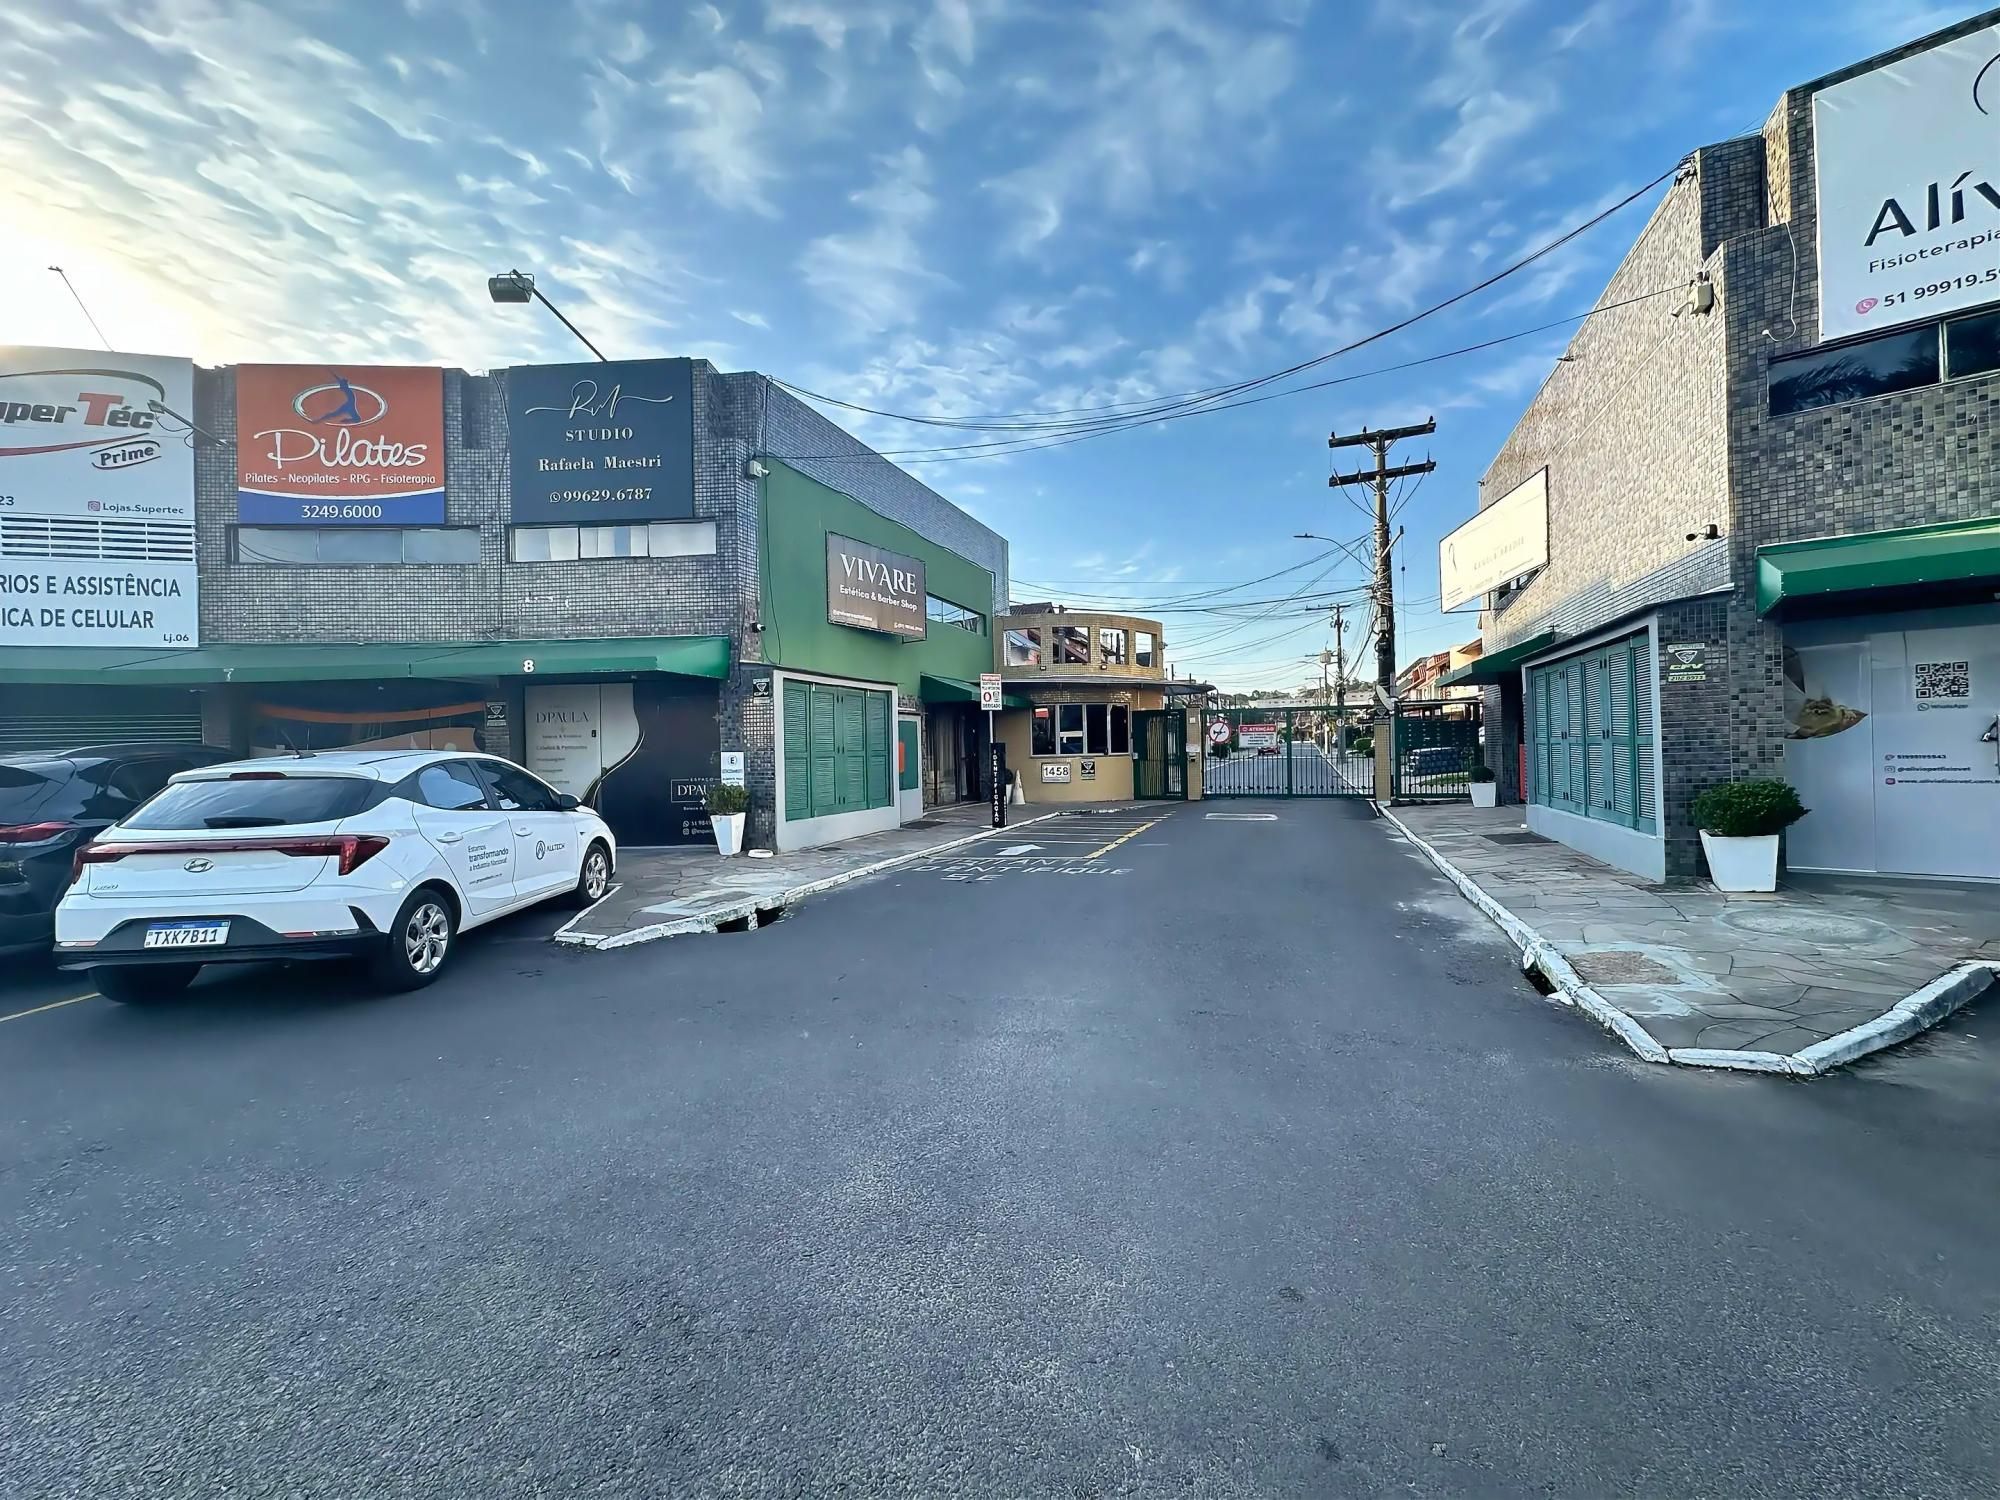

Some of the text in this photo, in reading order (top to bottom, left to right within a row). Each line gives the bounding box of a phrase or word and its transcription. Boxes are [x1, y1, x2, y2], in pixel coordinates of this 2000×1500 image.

[1884, 268, 2000, 307] 51 99919.5
[566, 427, 633, 442] STUDIO
[100, 446, 154, 466] Prime
[254, 428, 428, 470] Pilates
[538, 454, 662, 472] Rafaela Maestri
[245, 473, 279, 484] Pilates
[288, 473, 340, 485] Neopilates
[350, 474, 371, 484] RPG
[381, 473, 436, 486] Fisioterapia
[563, 487, 653, 503] 99629.6787
[103, 502, 184, 515] Lojas.Supertec
[301, 505, 382, 519] 3249.6000
[840, 553, 917, 595] VIVARE
[46, 575, 57, 594] E
[63, 573, 181, 597] ASSISTÊNCIA
[840, 584, 917, 612] Estética & Barber Shop
[40, 608, 66, 627] DE
[72, 609, 154, 628] CELULAR
[163, 633, 190, 643] Lj.06
[523, 660, 535, 673] 8
[223, 668, 234, 681] 7
[1044, 766, 1069, 776] 1458
[468, 844, 487, 853] Estamos
[469, 847, 509, 862] transformando
[154, 929, 218, 945] TXK7B11
